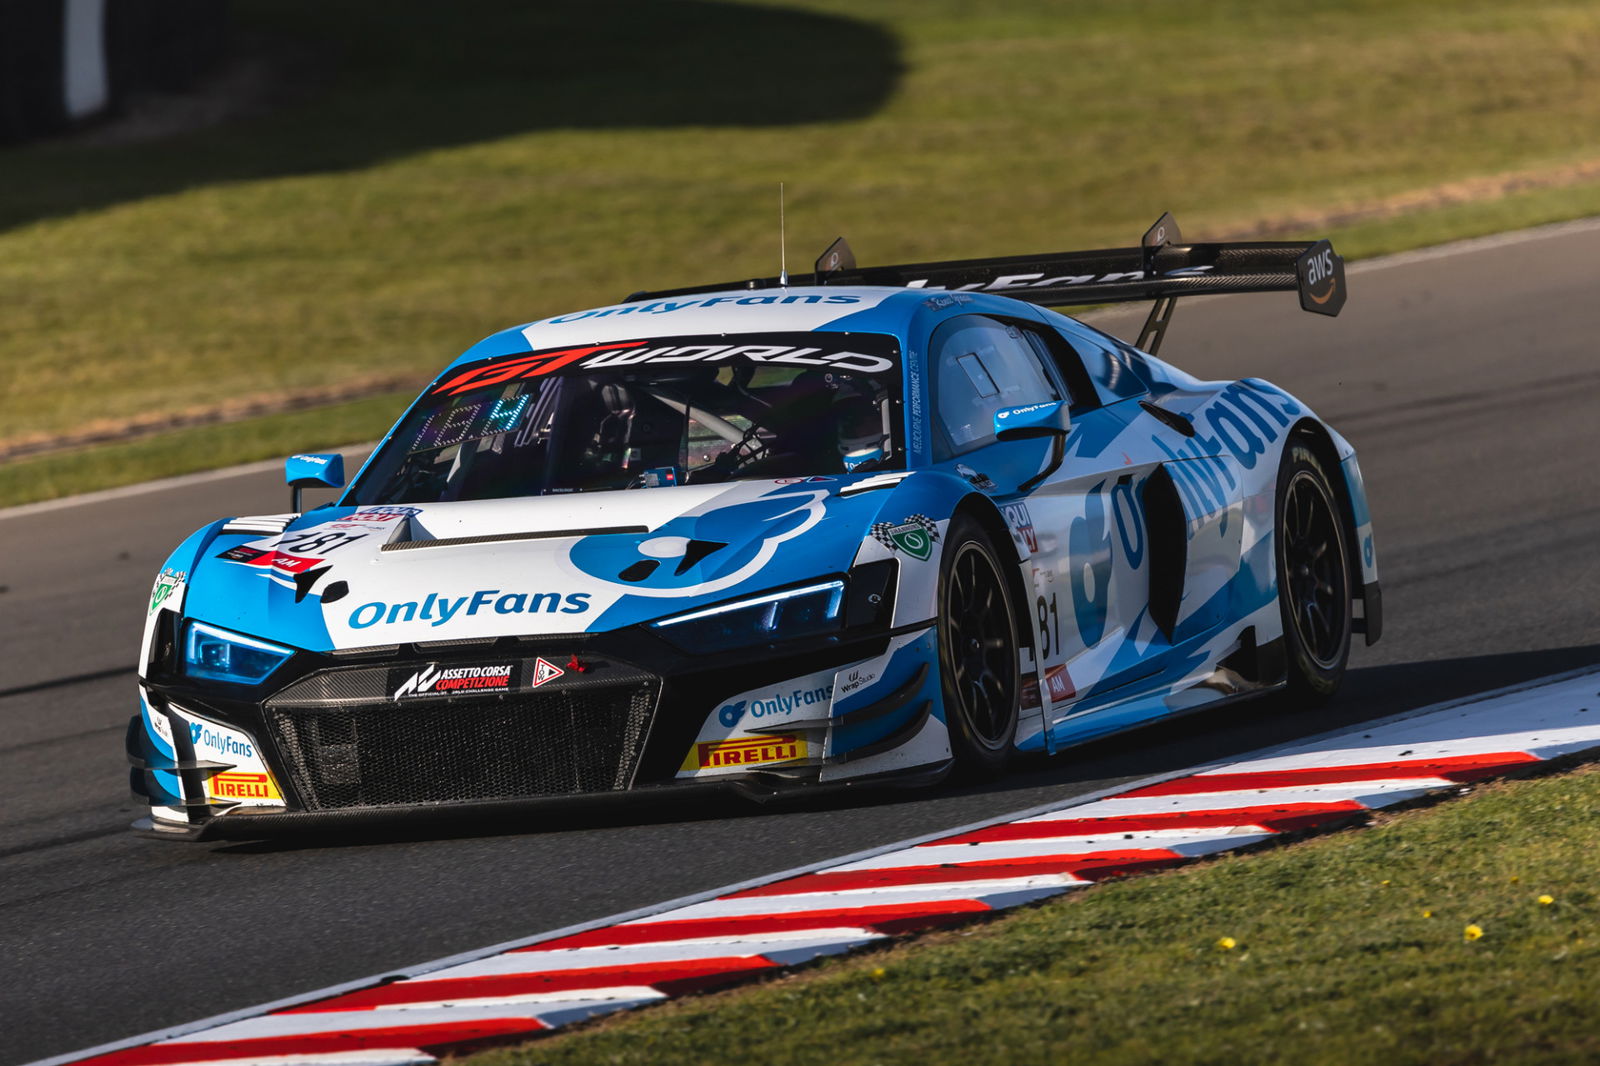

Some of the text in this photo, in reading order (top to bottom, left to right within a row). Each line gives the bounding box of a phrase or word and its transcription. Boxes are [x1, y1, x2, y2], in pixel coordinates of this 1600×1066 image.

[1307, 249, 1333, 285] aws
[548, 293, 861, 325] OnlyFans
[431, 341, 893, 396] GT WORLD
[1001, 503, 1032, 529] QUI
[272, 558, 301, 567] AM
[348, 590, 592, 629] OnlyFans
[1028, 592, 1060, 662] 81
[436, 676, 509, 690] COMPETIZIONE
[441, 665, 510, 679] ASSETTO CORSA
[1051, 675, 1066, 692] AM
[751, 685, 834, 718] OnlyFans
[204, 729, 252, 758] OnlyFans
[698, 735, 798, 767] PIRELLI
[213, 773, 269, 797] PIRELLI
